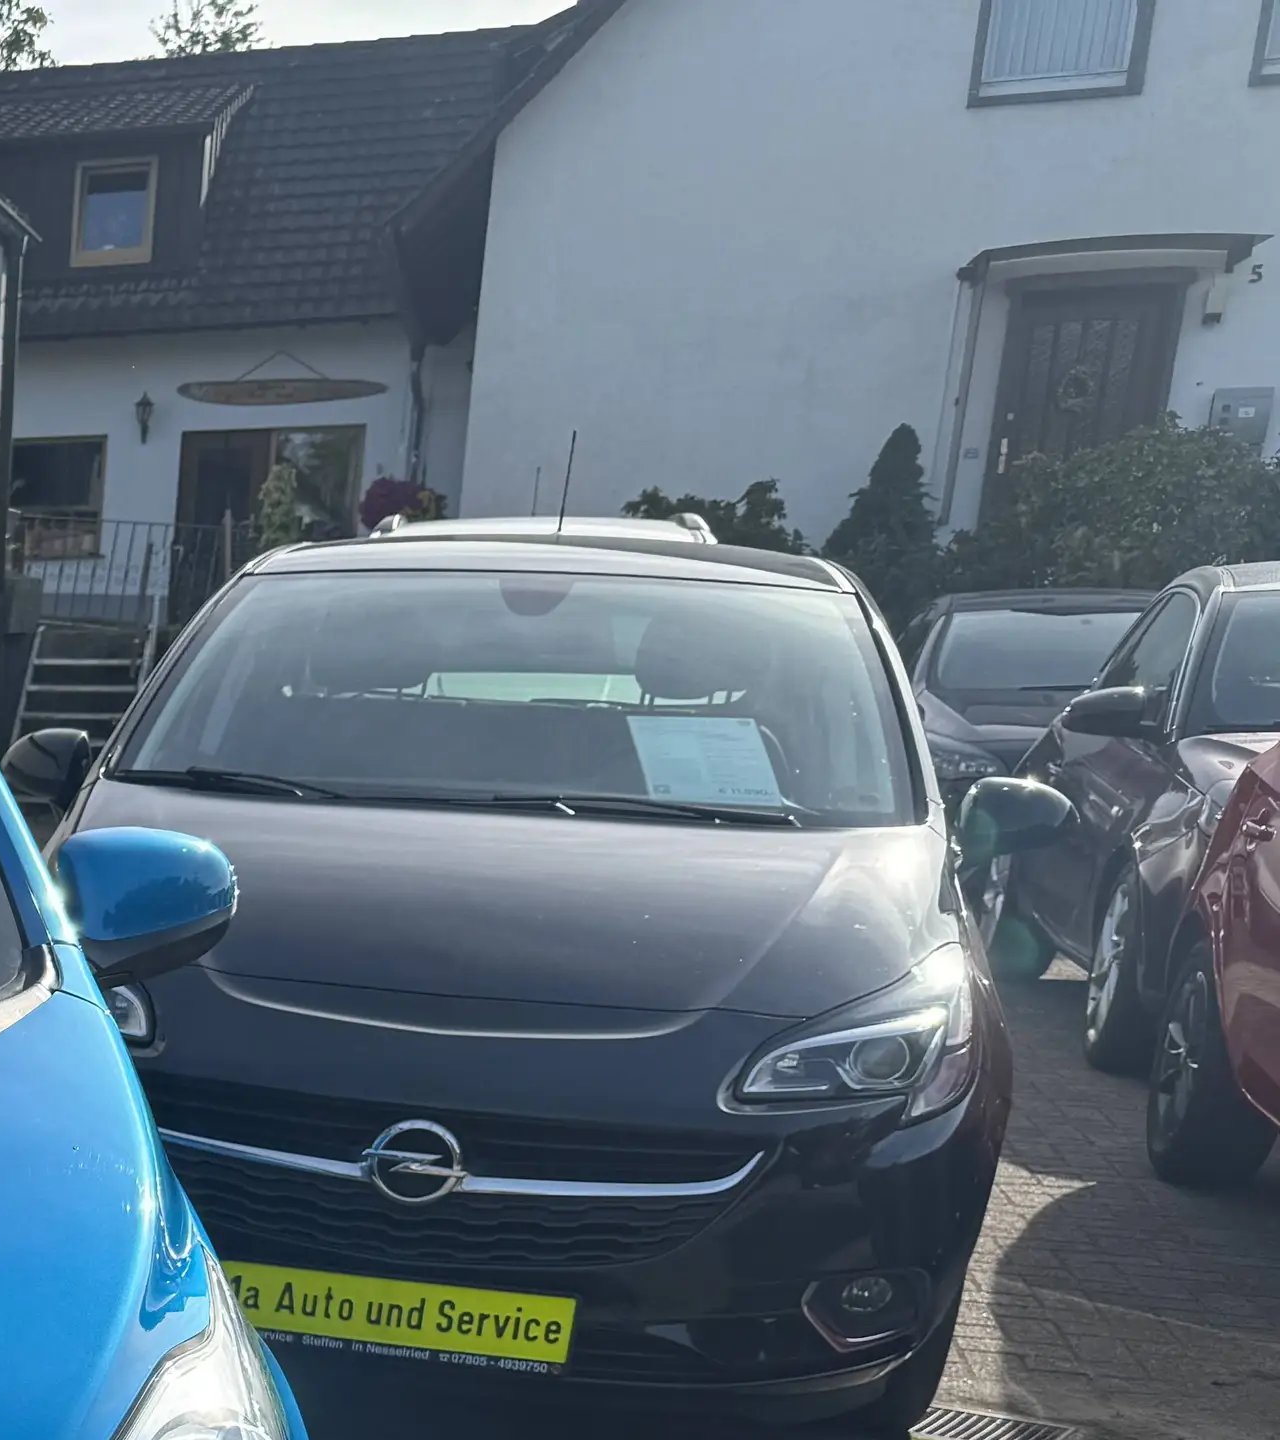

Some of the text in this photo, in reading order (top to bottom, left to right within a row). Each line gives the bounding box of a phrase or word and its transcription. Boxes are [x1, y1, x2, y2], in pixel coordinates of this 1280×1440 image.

[1248, 263, 1264, 284] 5
[275, 1282, 354, 1321] Auto
[366, 1298, 426, 1331] und
[436, 1300, 562, 1344] Service
[301, 1335, 344, 1350] Steffen
[352, 1341, 364, 1352] in
[366, 1343, 430, 1361] Nesselried
[452, 1353, 488, 1367] 07805
[497, 1357, 548, 1374] 4939750
